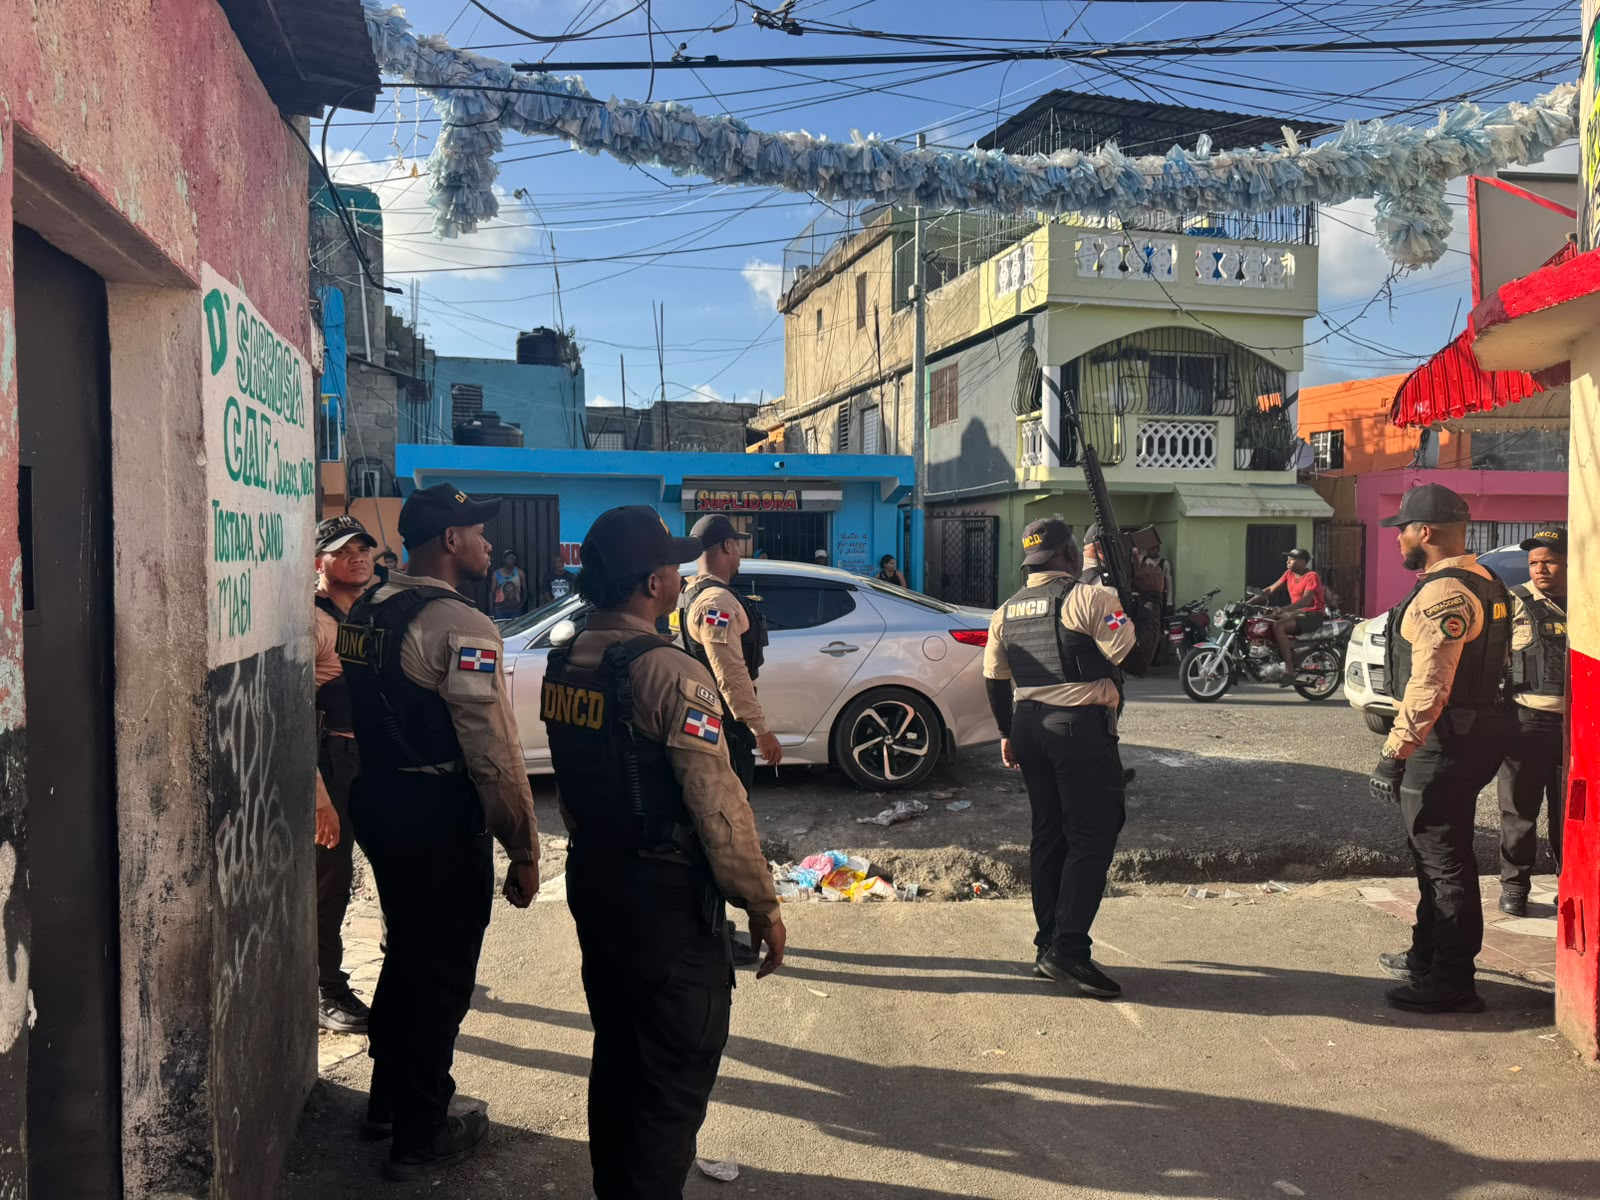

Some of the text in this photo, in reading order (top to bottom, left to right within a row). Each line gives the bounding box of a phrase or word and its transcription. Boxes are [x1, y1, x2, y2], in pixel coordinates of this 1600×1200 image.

[203, 288, 305, 429] D' SABROSA
[698, 489, 798, 510] SUPLIDORA
[258, 511, 284, 562] SAND
[217, 567, 252, 642] MABI
[1007, 600, 1047, 618] DNCD
[543, 682, 605, 730] DNCD
